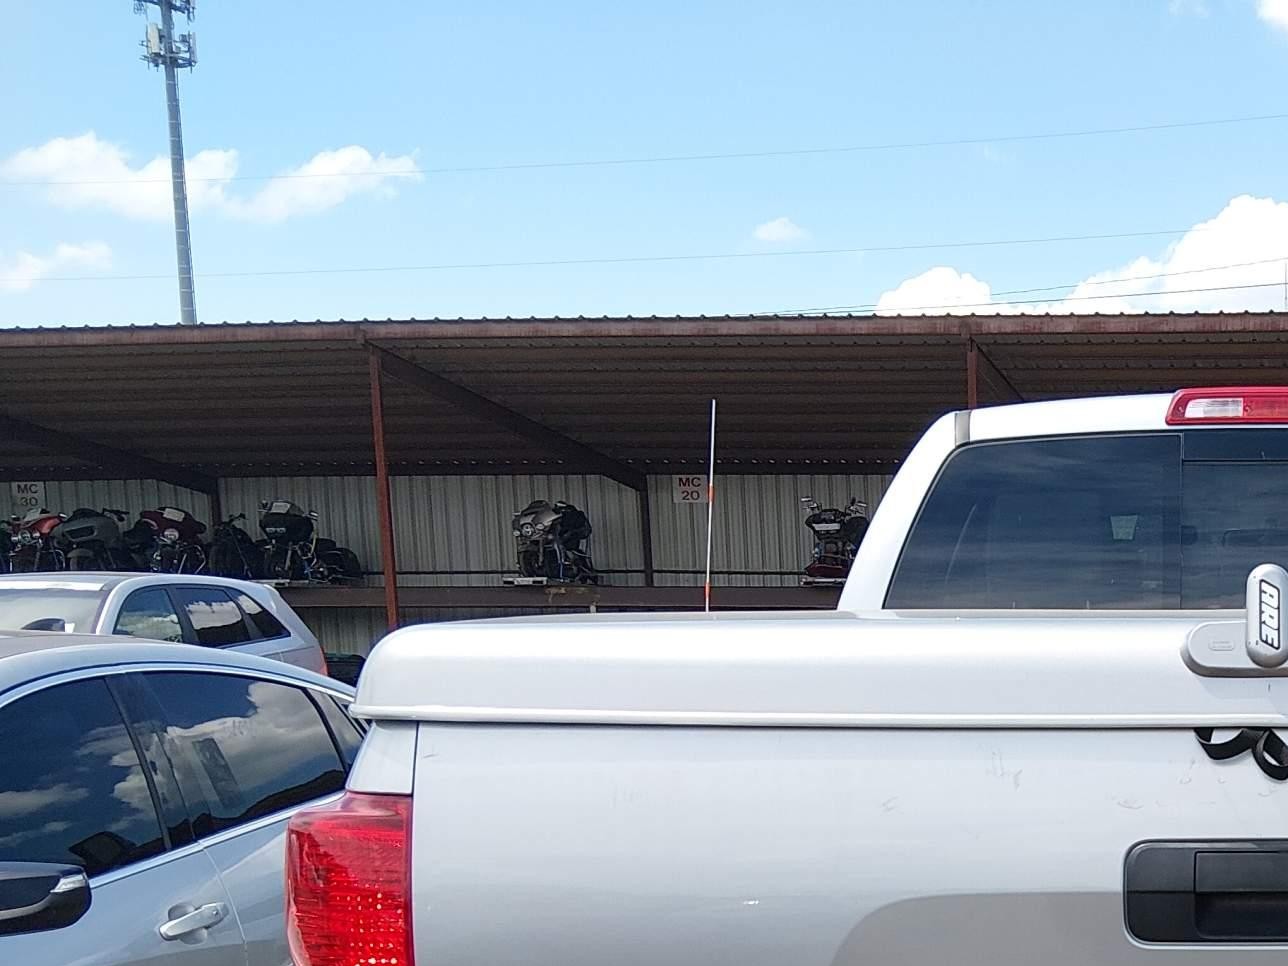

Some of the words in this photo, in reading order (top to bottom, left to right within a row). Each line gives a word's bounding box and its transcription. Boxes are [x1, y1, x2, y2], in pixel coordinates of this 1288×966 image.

[677, 476, 701, 488] MC
[16, 483, 39, 494] MC
[681, 490, 700, 501] 20
[20, 496, 38, 507] 30
[1259, 579, 1281, 650] ARE
